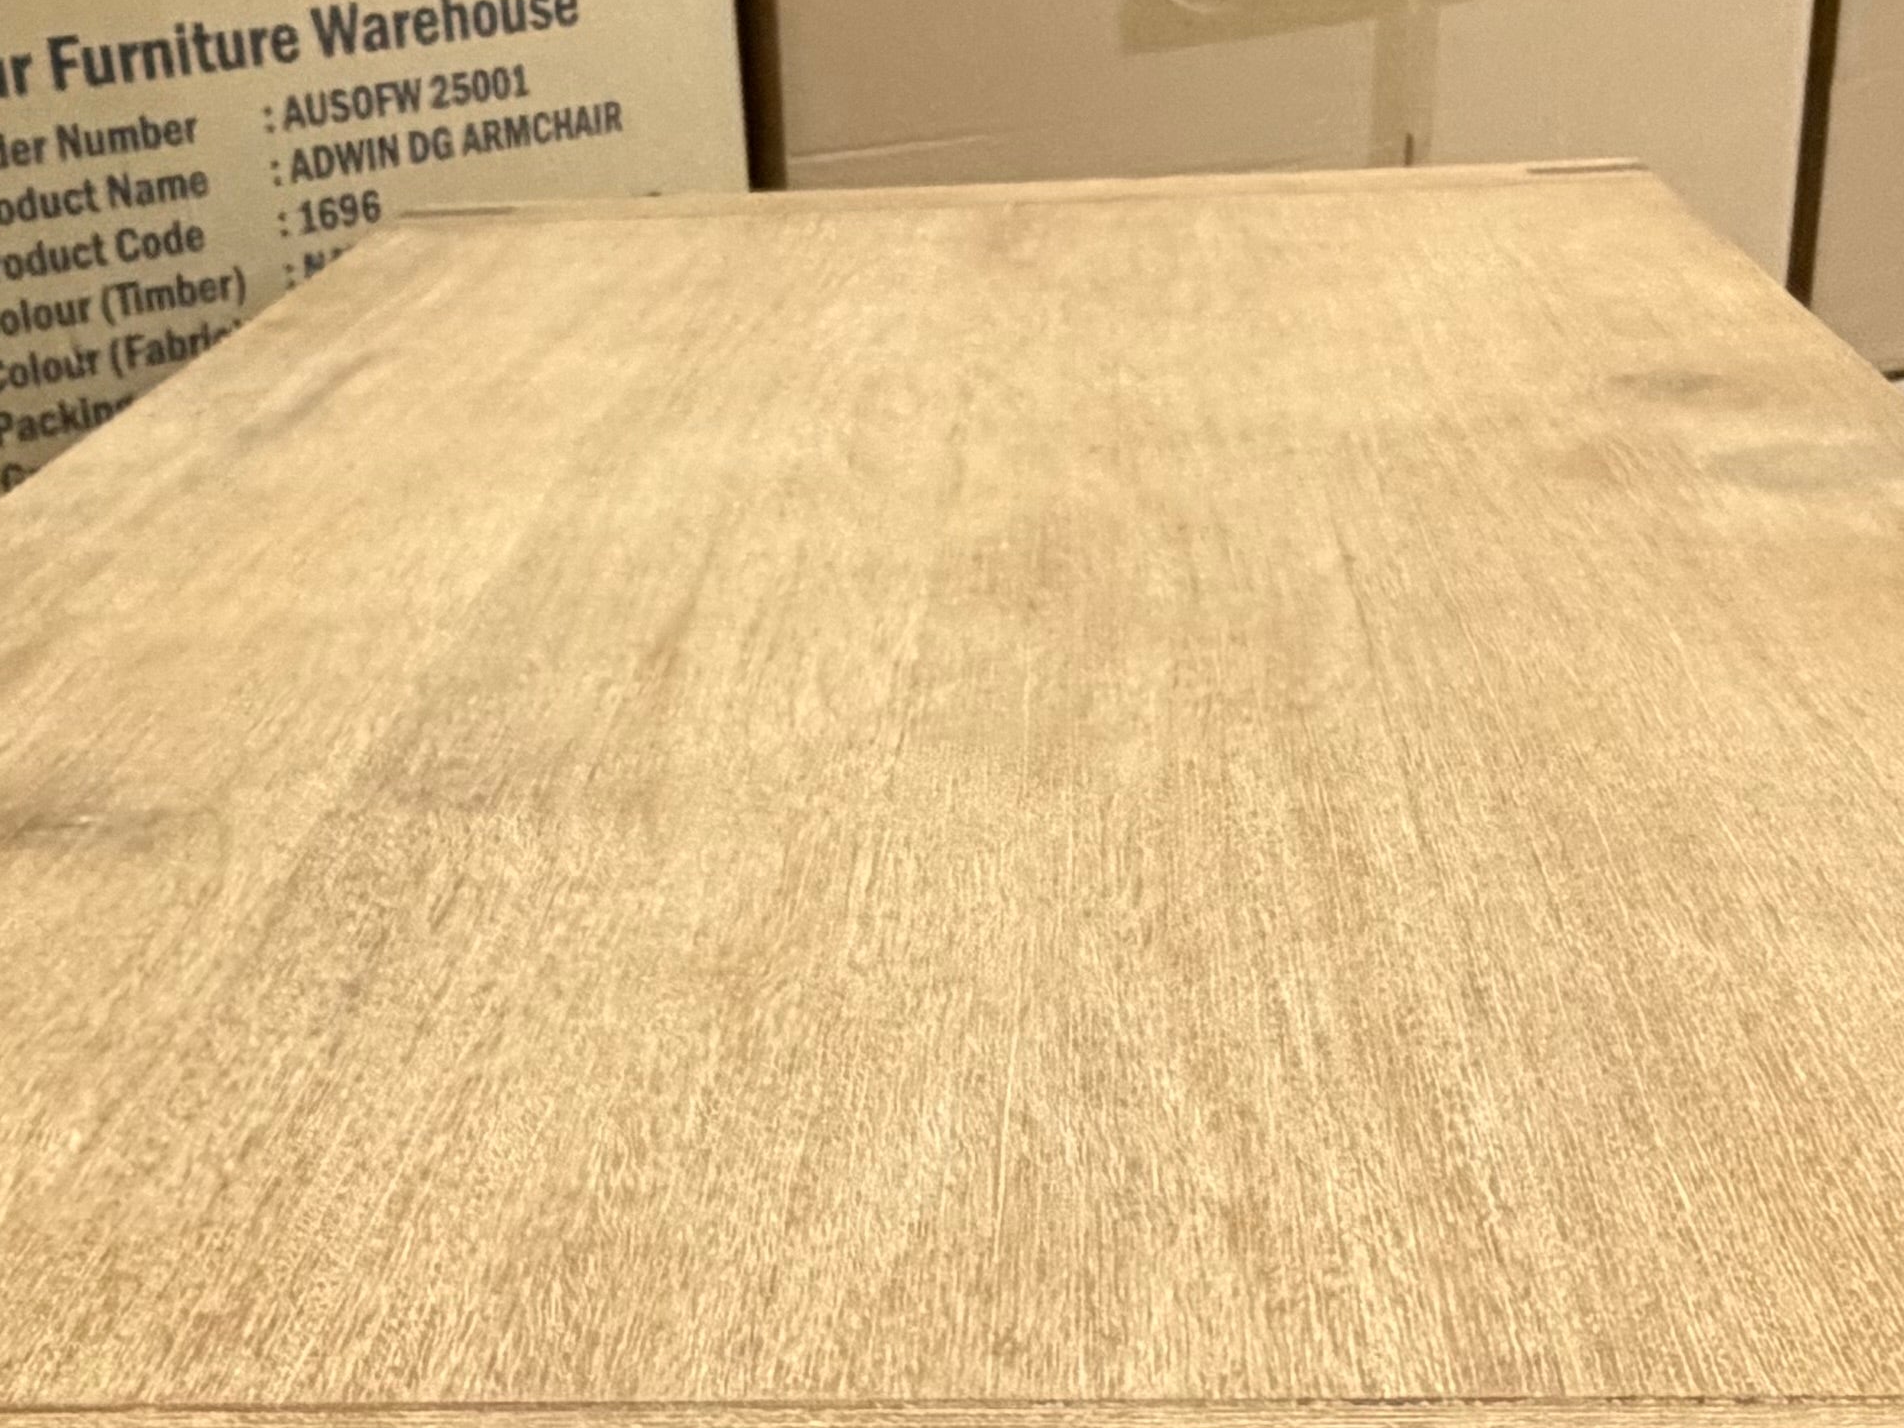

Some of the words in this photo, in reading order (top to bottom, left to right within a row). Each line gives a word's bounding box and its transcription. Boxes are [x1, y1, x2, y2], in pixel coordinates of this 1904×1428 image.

[46, 21, 301, 92] Furniture
[54, 115, 199, 162] Number
[282, 76, 423, 132] AUSOFW
[429, 63, 531, 111] 25001
[106, 170, 210, 210] Name
[289, 132, 401, 184] ADWIN
[407, 126, 455, 165] DG
[461, 99, 623, 157] ARMCHAIR
[114, 219, 206, 264] Code
[298, 188, 382, 236] 1696
[100, 265, 248, 326] (Timber)
[108, 317, 244, 379] (Fabri
